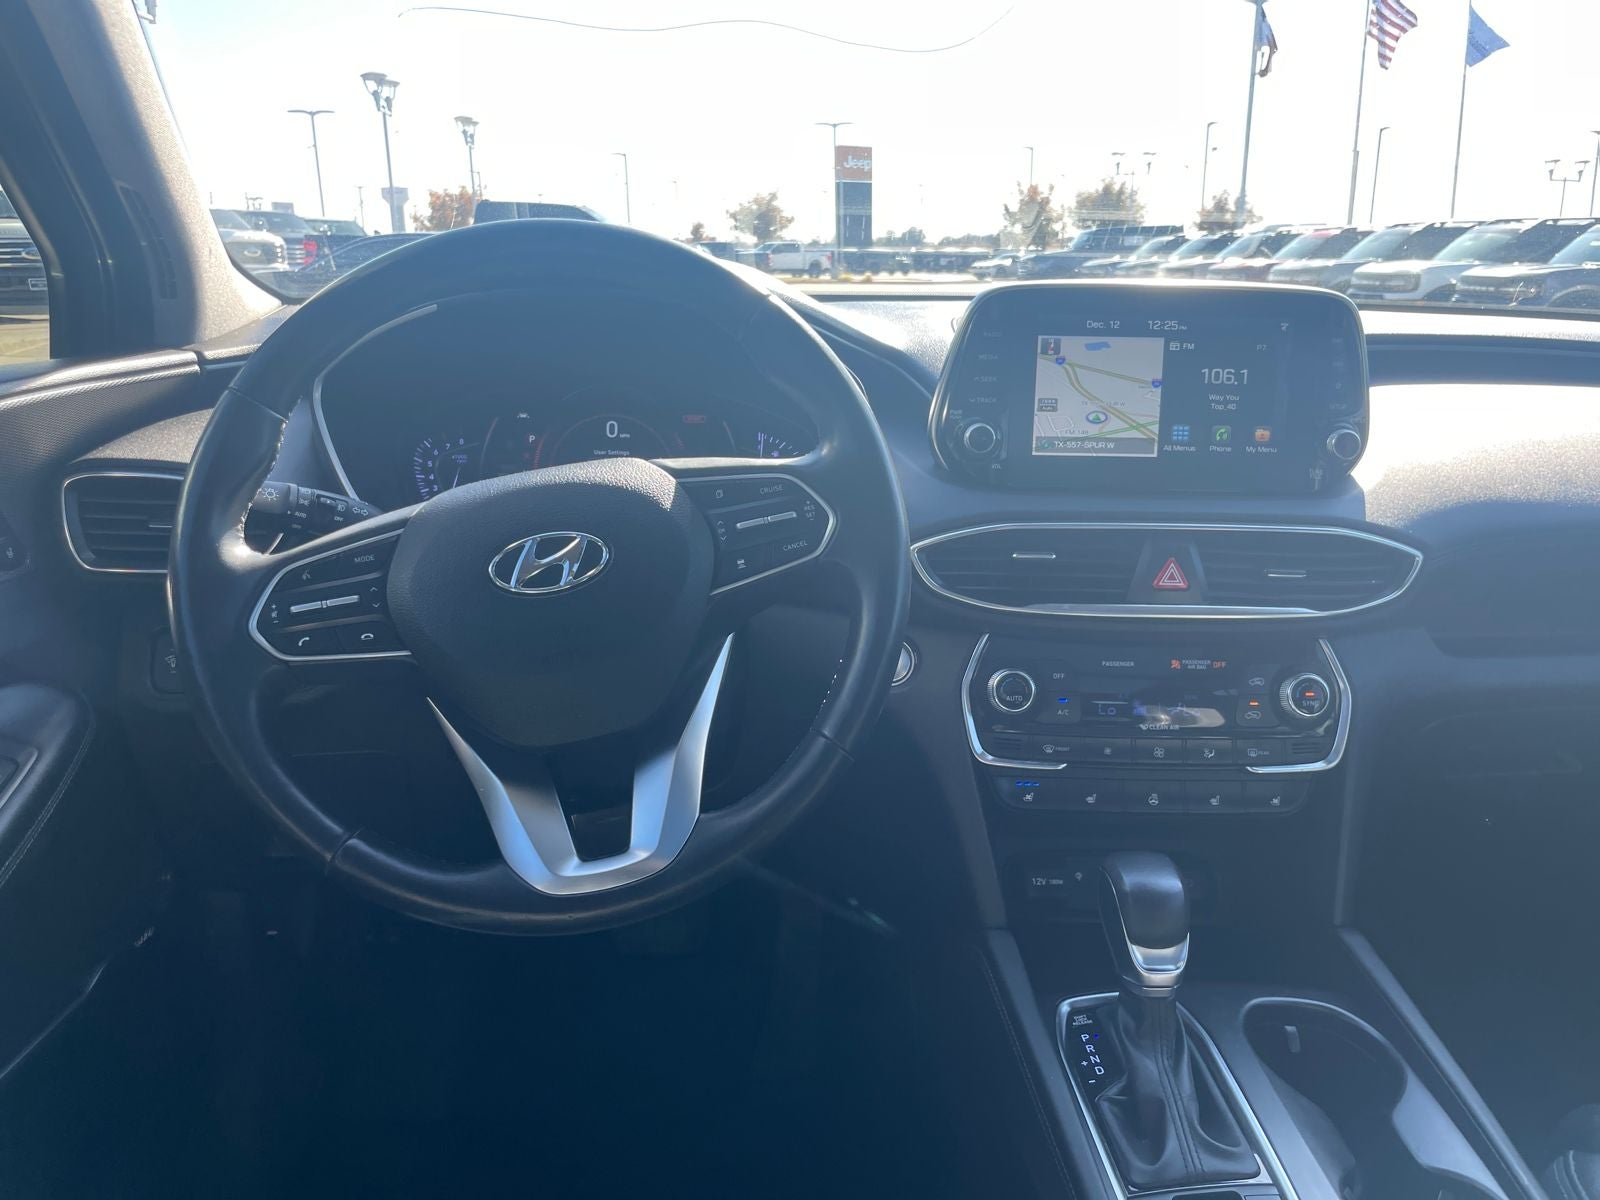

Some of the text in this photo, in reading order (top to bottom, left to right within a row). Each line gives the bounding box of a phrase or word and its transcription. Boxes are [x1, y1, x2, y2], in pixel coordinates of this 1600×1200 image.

[843, 154, 871, 171] Jeep
[1086, 320, 1120, 329] Dec. 12
[1147, 320, 1178, 330] 12:25
[1182, 342, 1195, 350] FM
[1201, 368, 1249, 385] 106.1
[606, 420, 618, 438] 0
[529, 434, 536, 443] P
[1173, 444, 1196, 452] Menus
[760, 485, 783, 494] CRUISE
[783, 540, 808, 551] CANCEL
[354, 554, 375, 563] MODE
[1213, 661, 1227, 669] OFF
[1081, 1033, 1089, 1042] P
[1086, 1044, 1095, 1053] R
[1090, 1054, 1100, 1064] N
[1095, 1066, 1105, 1075] D
